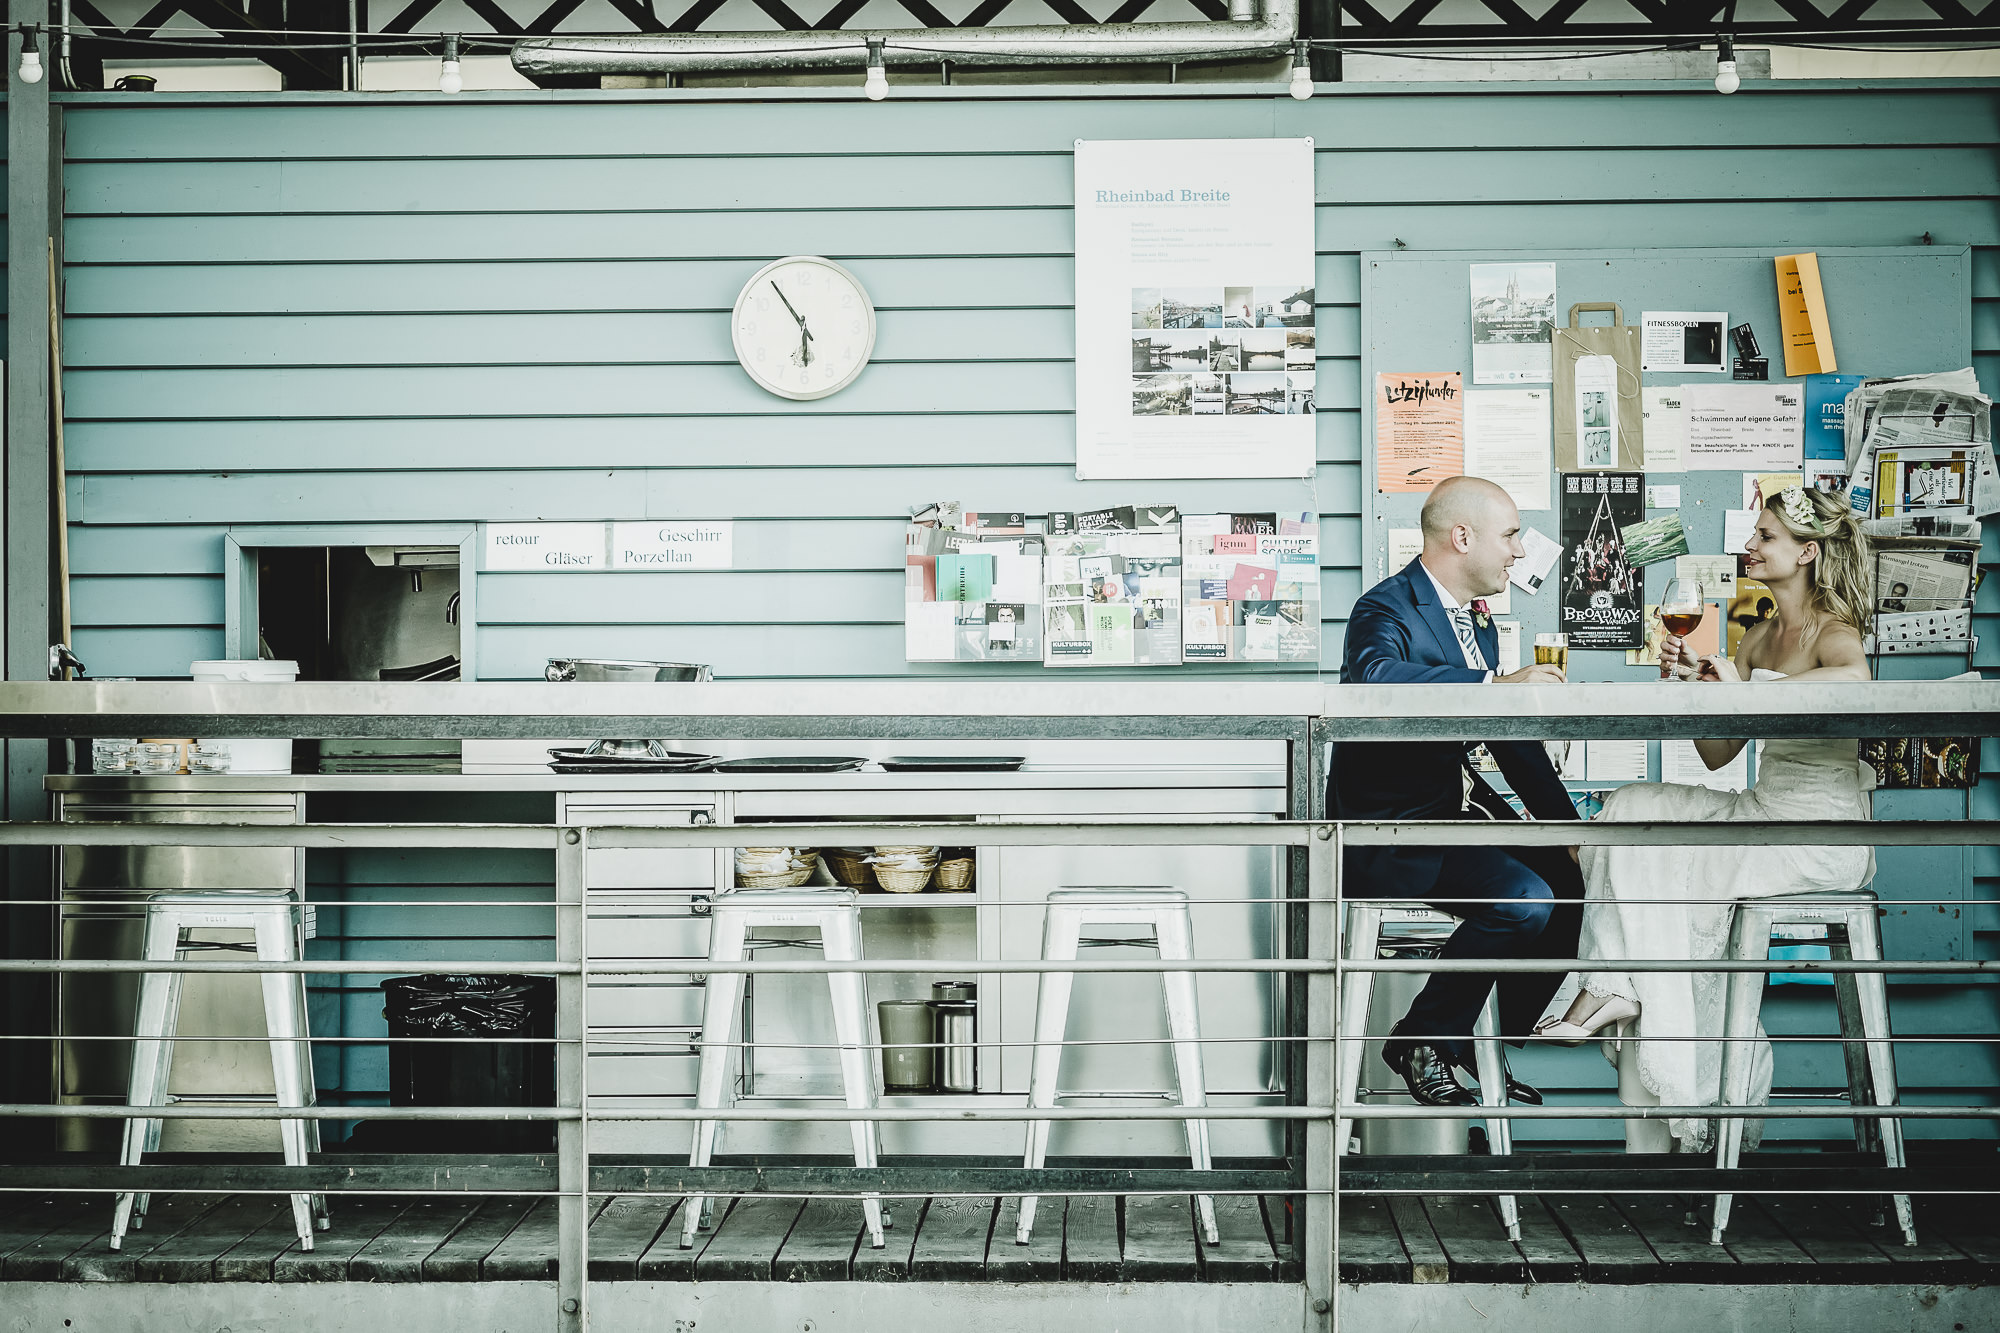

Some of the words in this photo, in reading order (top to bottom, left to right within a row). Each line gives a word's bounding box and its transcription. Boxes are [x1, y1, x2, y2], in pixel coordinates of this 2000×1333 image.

[1095, 189, 1175, 203] Rheinbad
[1180, 189, 1231, 202] Breite
[796, 271, 812, 286] 12
[756, 297, 770, 312] 10
[841, 294, 853, 309] 2
[746, 321, 757, 336] 9
[851, 320, 861, 335] 3
[756, 347, 766, 362] 8
[841, 345, 851, 360] 4
[776, 364, 785, 379] 7
[799, 370, 810, 385] 6
[824, 363, 834, 378] 5
[1385, 379, 1458, 407] Letziplunder
[1822, 403, 1844, 414] ma
[495, 533, 540, 546] retour
[658, 528, 723, 542] Geschirr
[1220, 537, 1247, 551] ignm
[1261, 539, 1312, 548] CULTURE
[545, 551, 593, 565] Gläser
[624, 549, 693, 564] Porzellan
